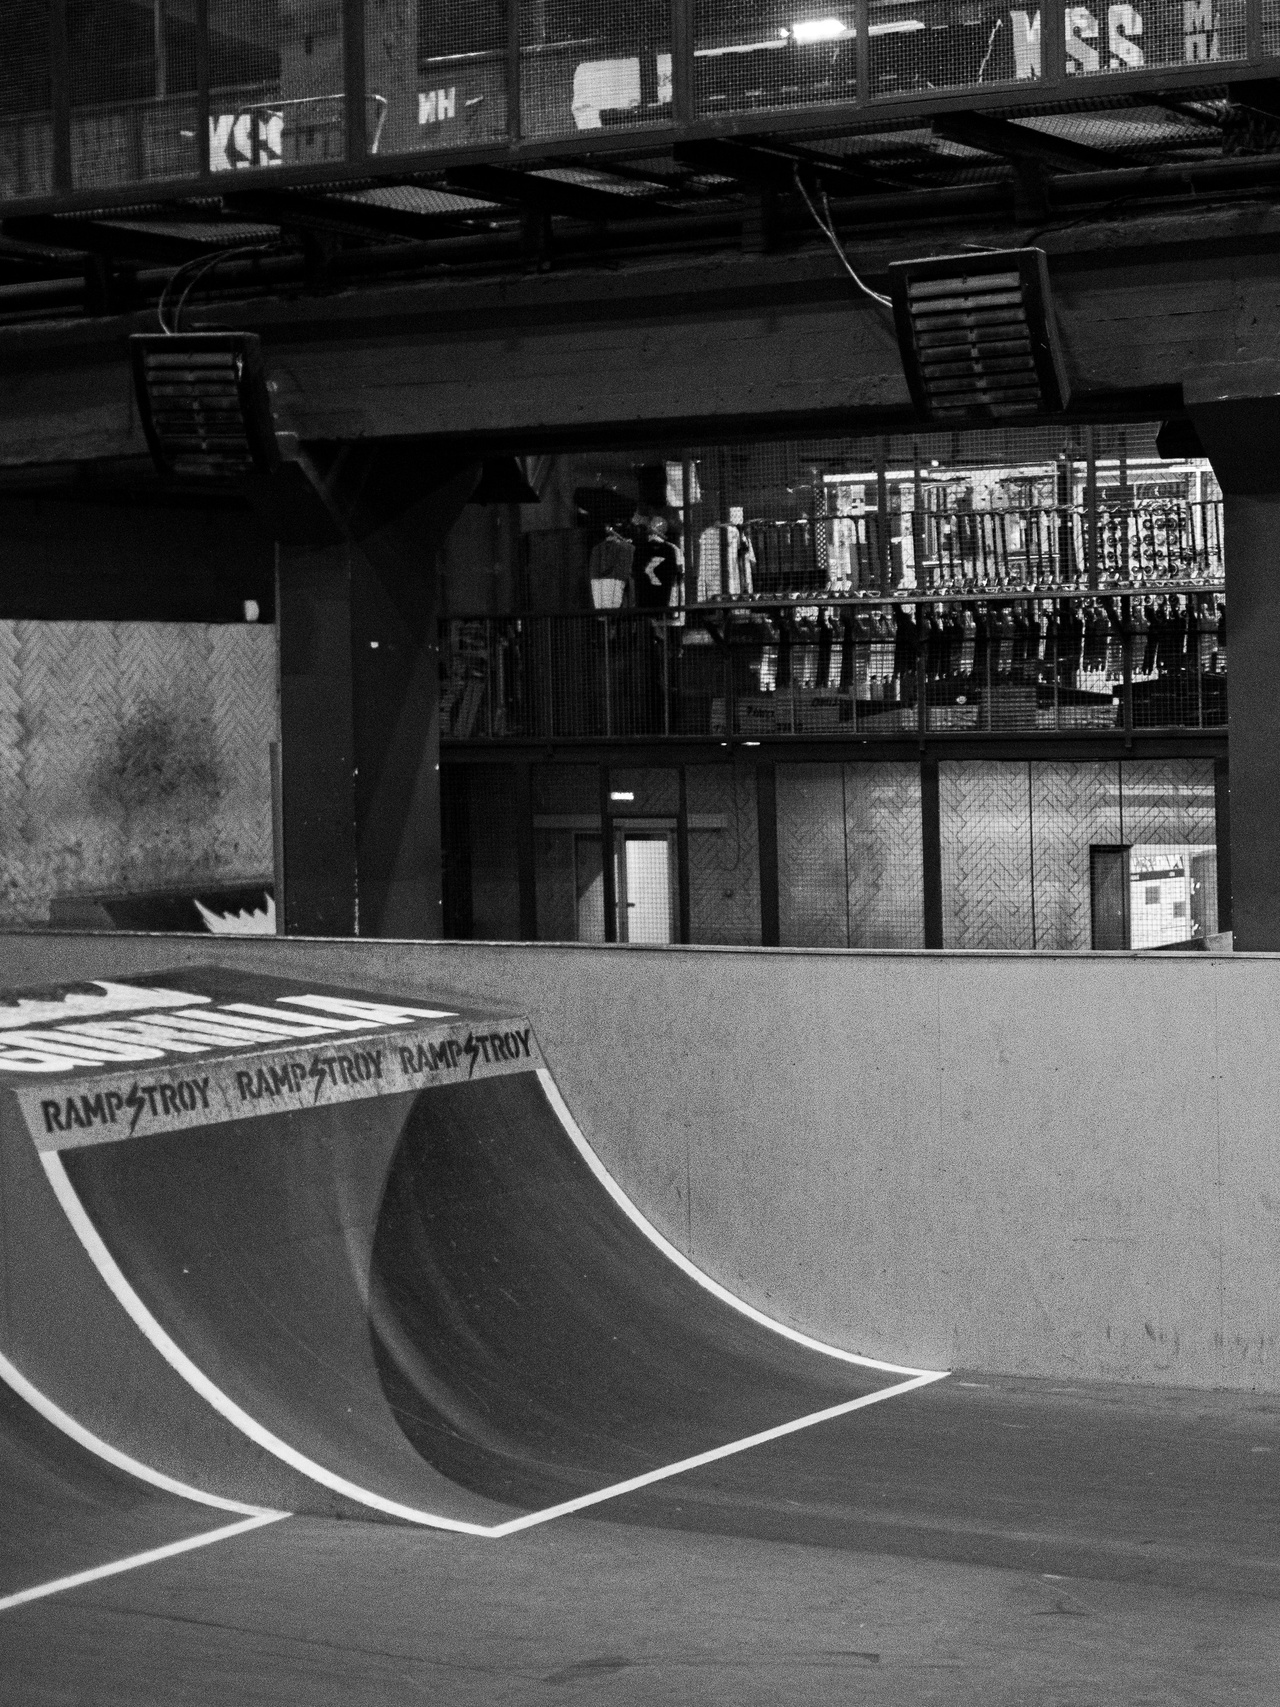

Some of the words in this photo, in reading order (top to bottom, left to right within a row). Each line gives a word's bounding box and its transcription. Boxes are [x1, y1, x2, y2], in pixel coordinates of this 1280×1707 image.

[42, 1078, 211, 1136] RAMPSTROY
[236, 1050, 384, 1105] RAMPSTROY
[400, 1029, 532, 1079] RAMPSTROY
